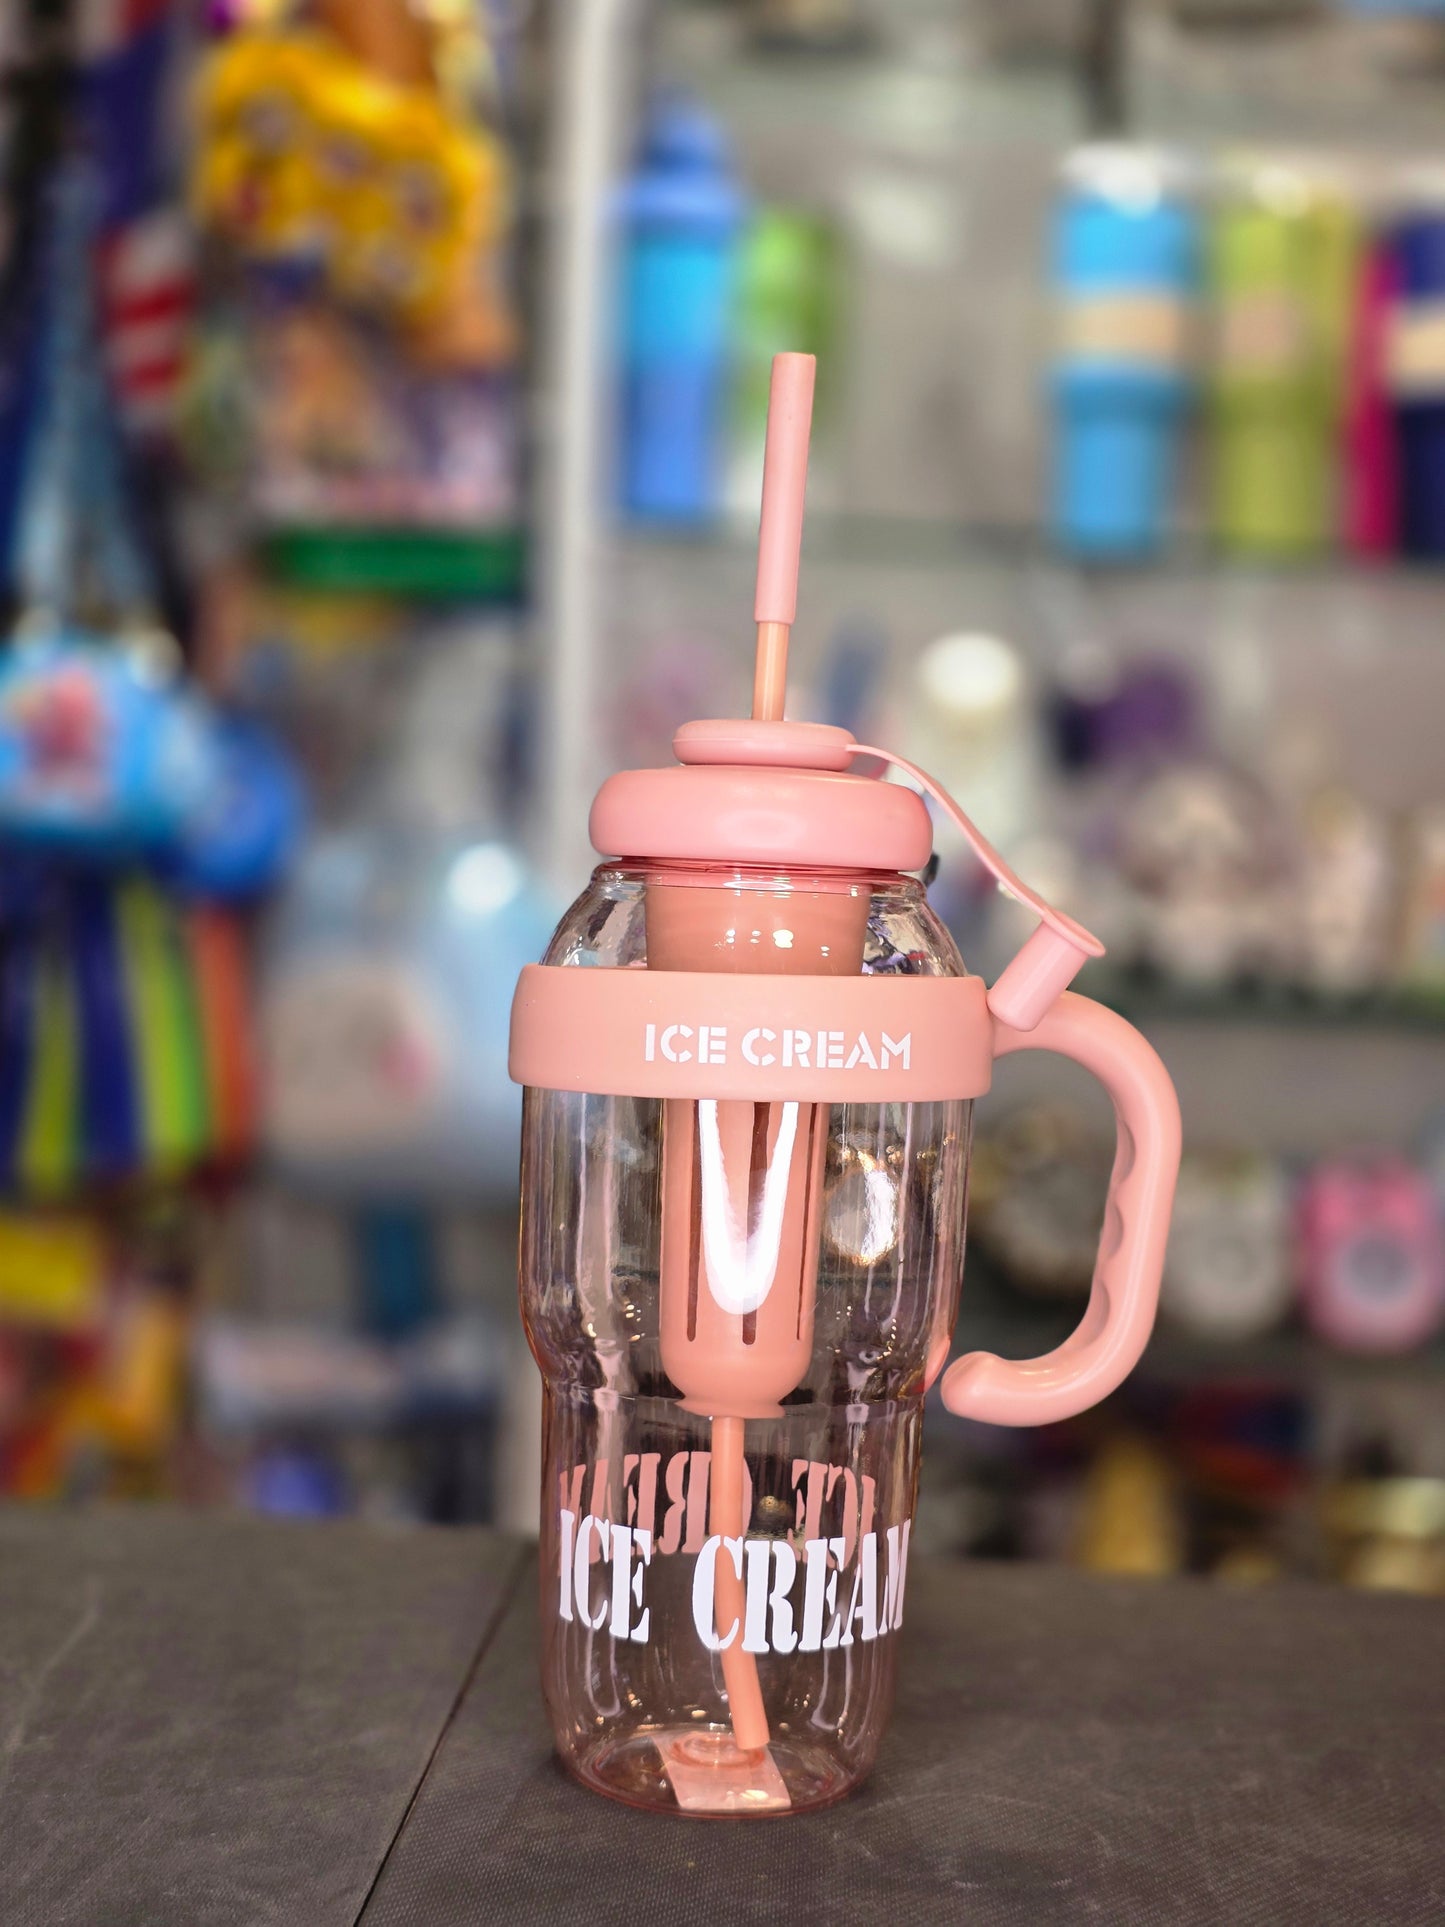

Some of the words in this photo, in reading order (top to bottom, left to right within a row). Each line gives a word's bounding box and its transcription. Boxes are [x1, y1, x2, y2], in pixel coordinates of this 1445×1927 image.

[645, 1024, 727, 1064] ICE
[741, 1027, 912, 1070] CREAM
[559, 1509, 652, 1642] ICE
[692, 1519, 911, 1653] CREAM
